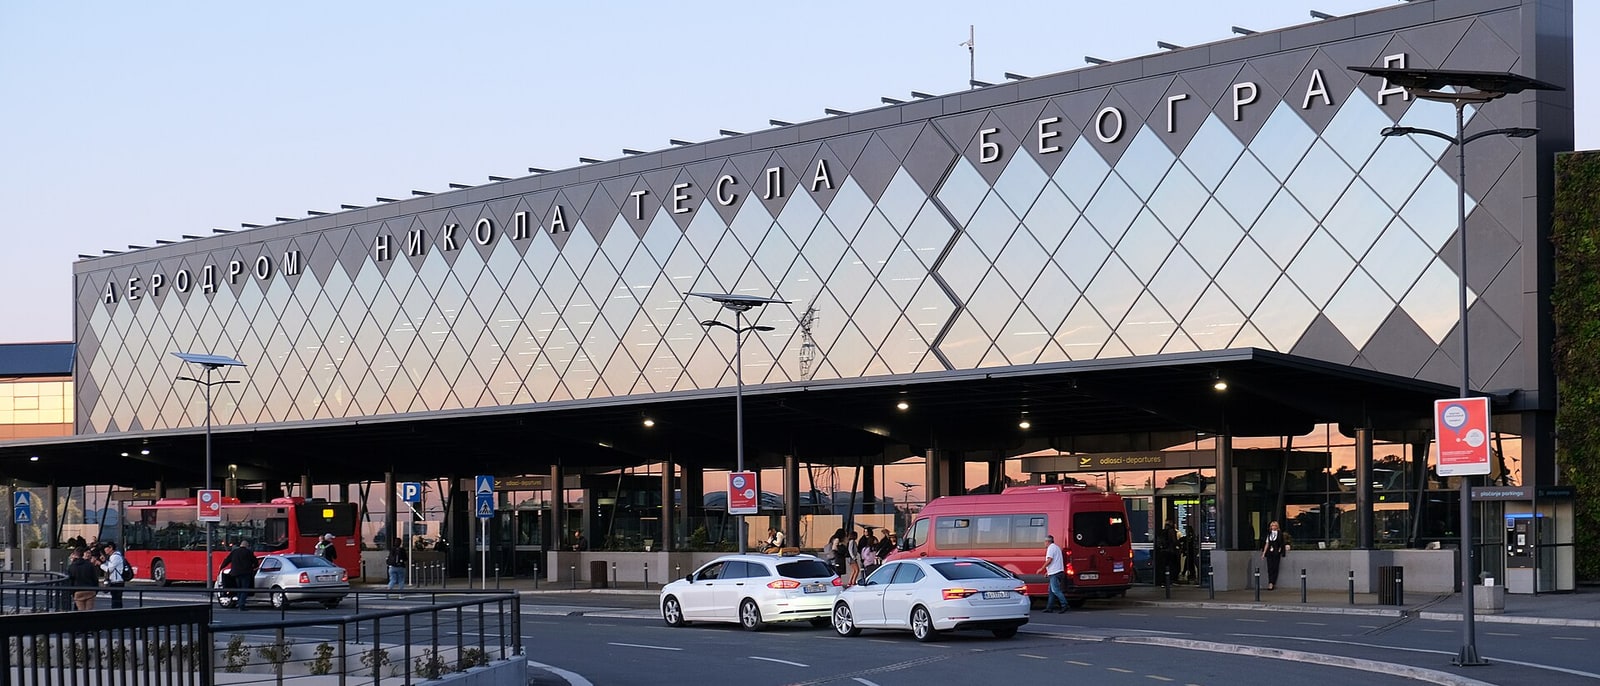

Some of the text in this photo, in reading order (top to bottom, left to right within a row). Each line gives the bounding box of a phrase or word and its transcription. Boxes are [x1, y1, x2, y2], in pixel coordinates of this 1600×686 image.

[104, 52, 1409, 304] АЕРОДРОМ НИКОЛА ТЕСЛА БЕОГРАД
[406, 485, 417, 500] P
